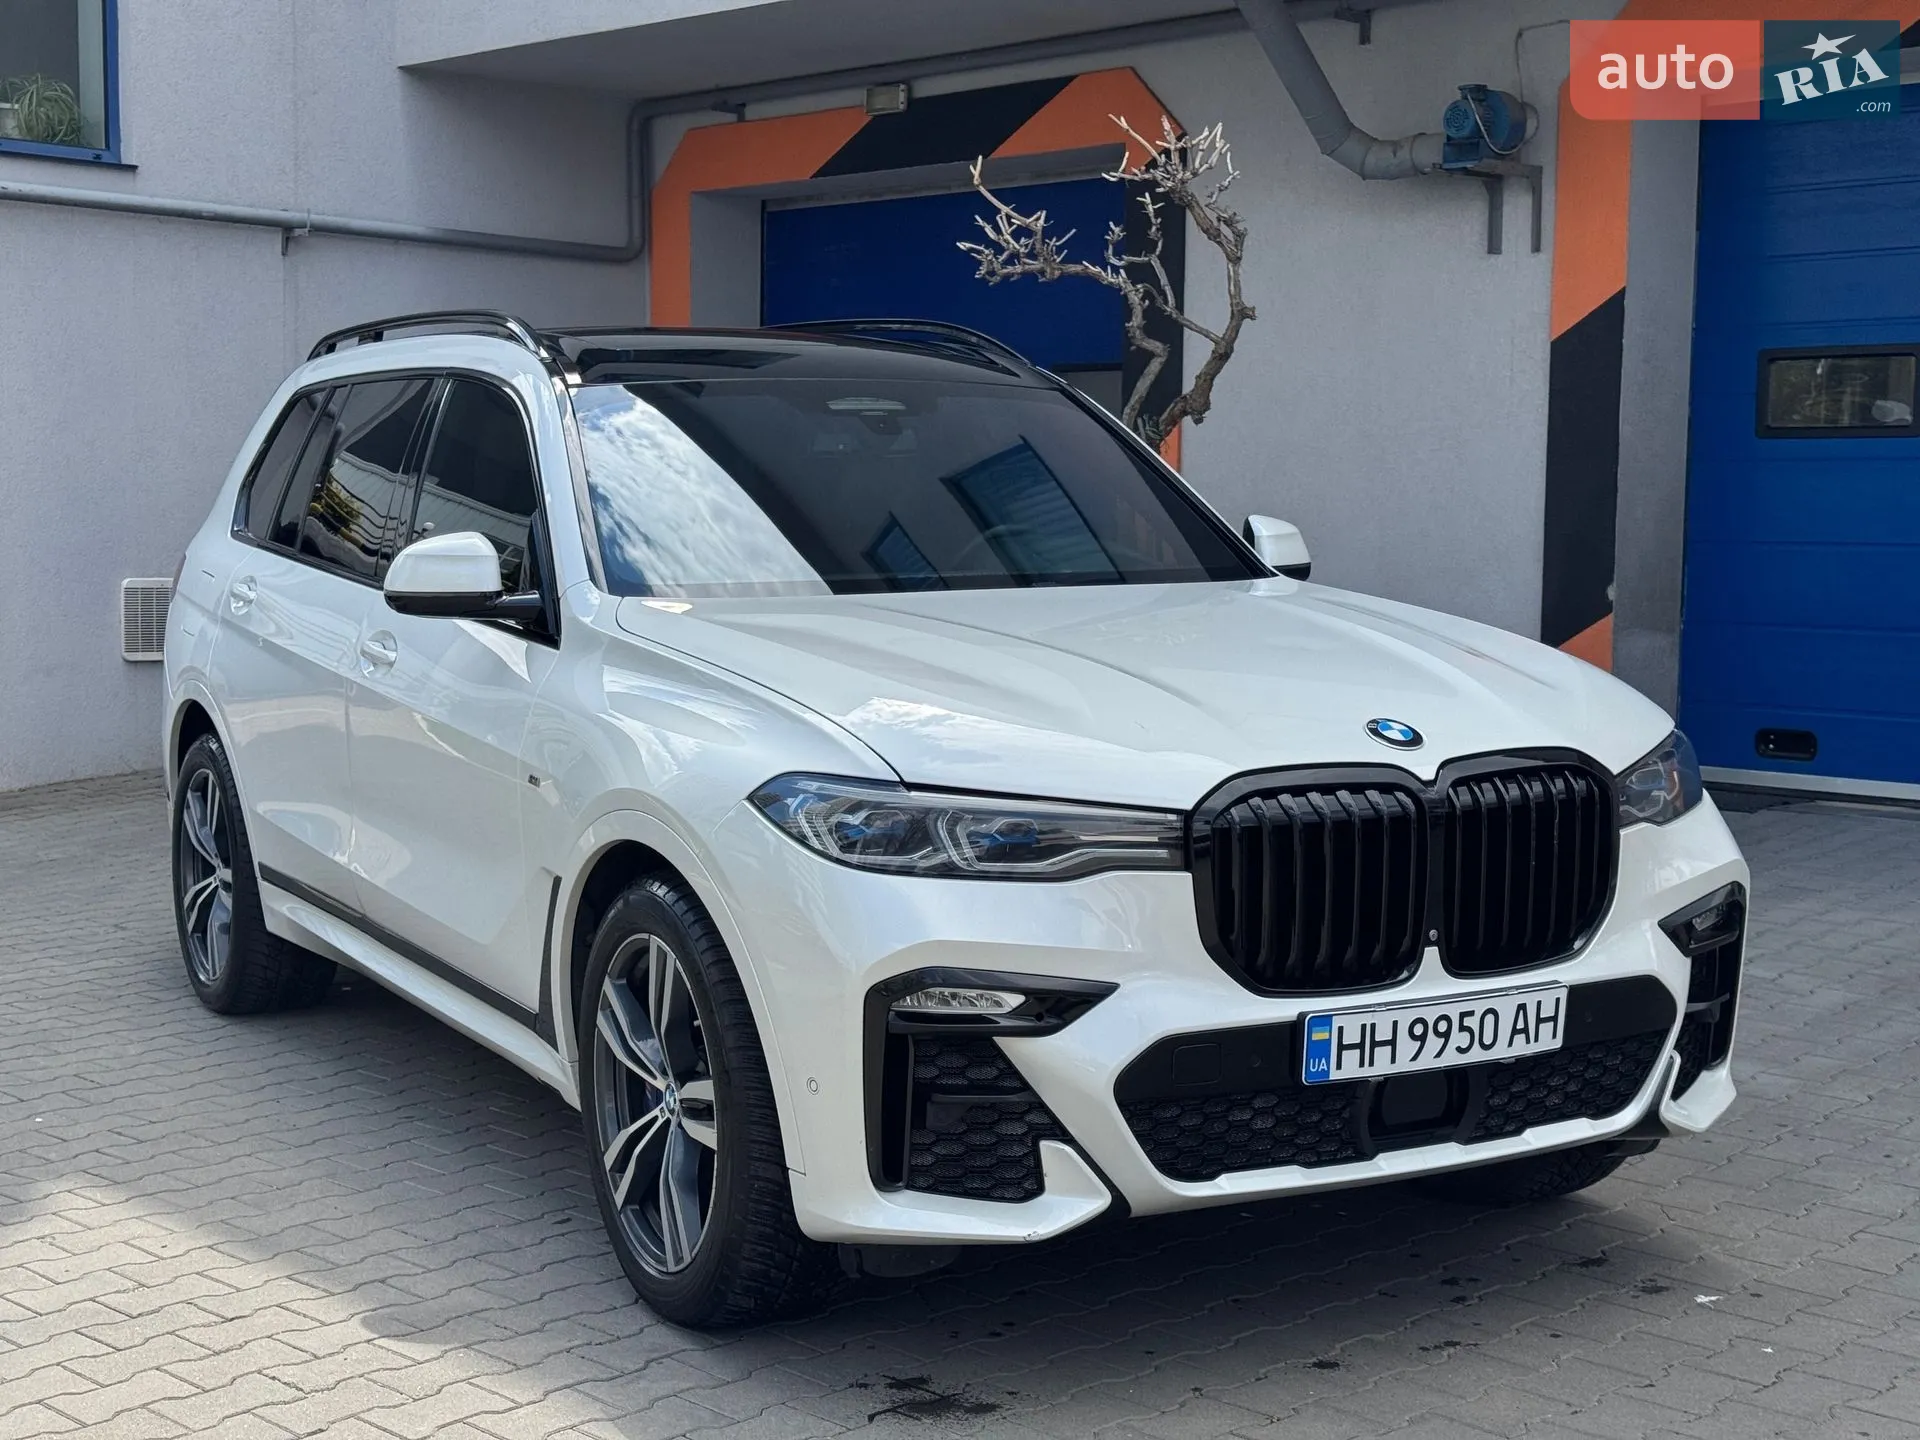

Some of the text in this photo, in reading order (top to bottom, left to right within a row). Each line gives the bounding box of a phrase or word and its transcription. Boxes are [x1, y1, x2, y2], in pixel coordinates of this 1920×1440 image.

[1336, 997, 1561, 1071] HH 9950 AH
[1309, 1058, 1328, 1072] UA
